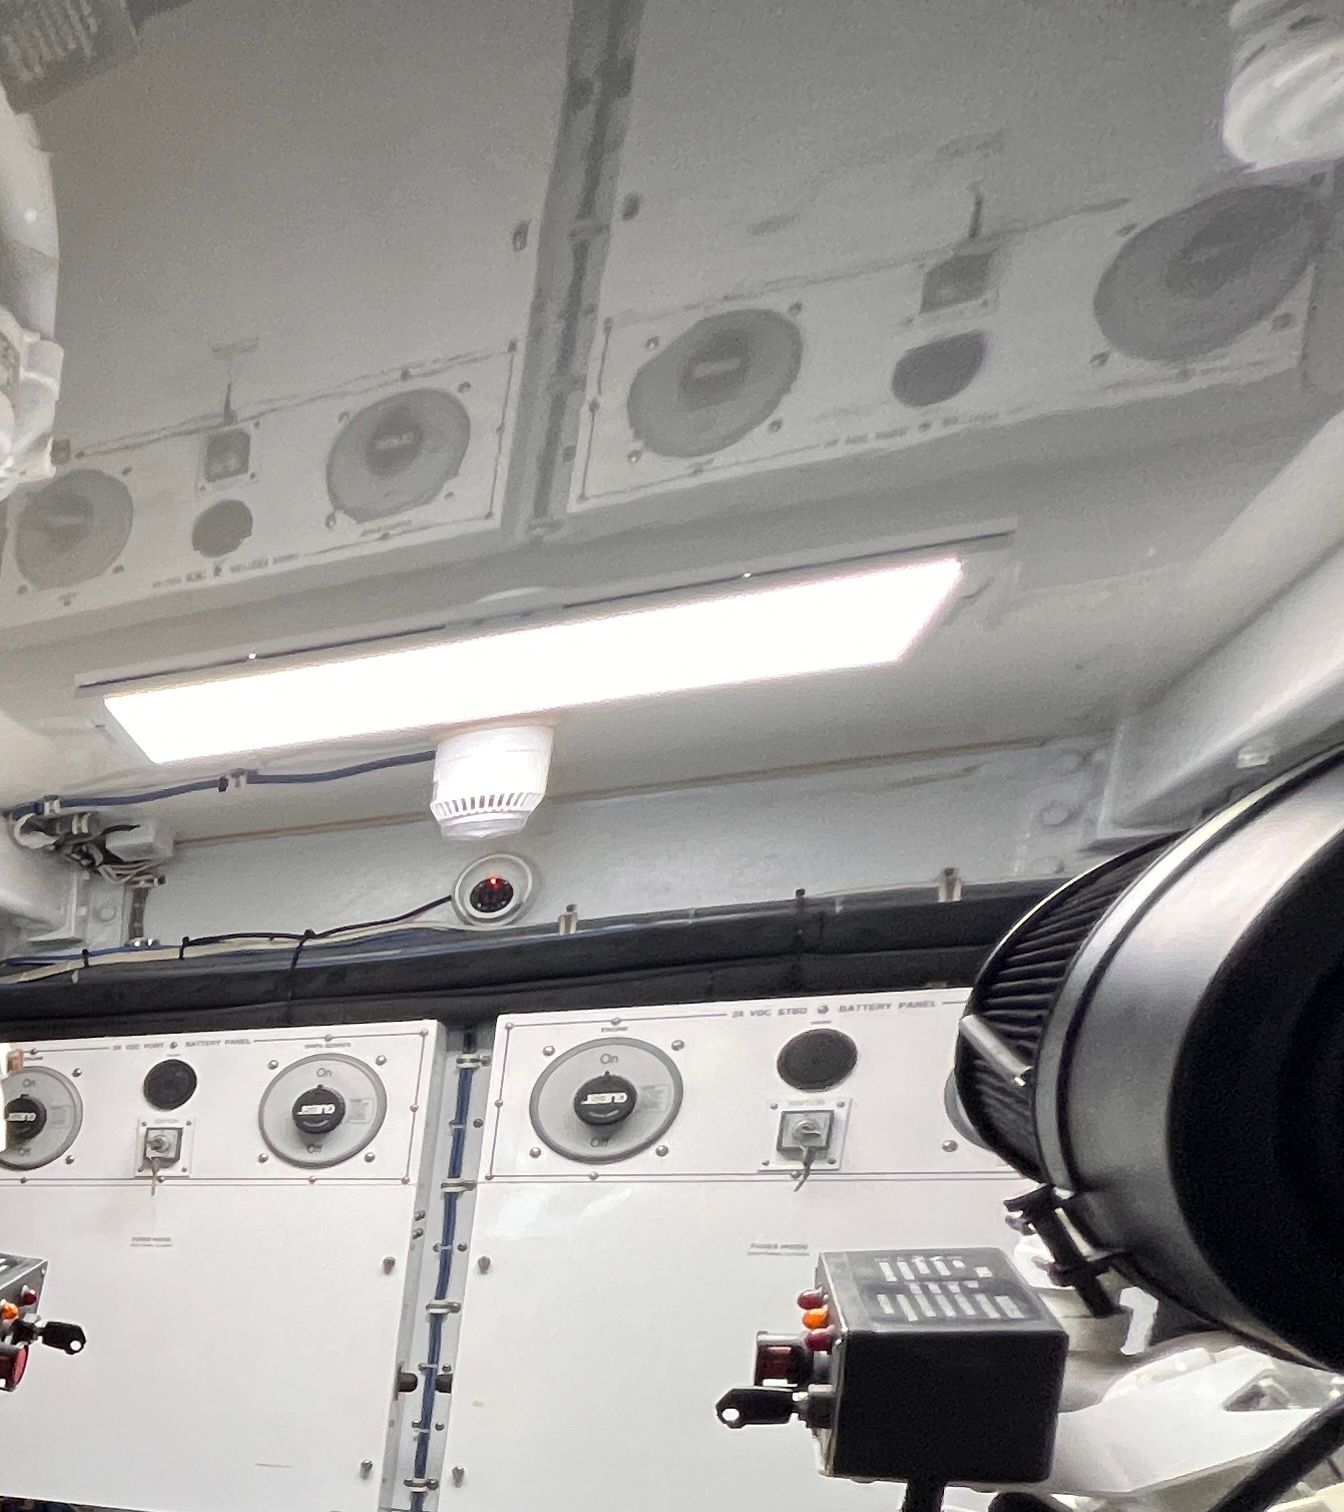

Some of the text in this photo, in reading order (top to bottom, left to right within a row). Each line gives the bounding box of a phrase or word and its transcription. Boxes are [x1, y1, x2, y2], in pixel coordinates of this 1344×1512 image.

[838, 1002, 892, 1013] BATTERY
[898, 1000, 937, 1009] PANEL
[185, 1040, 221, 1048] BATTERY
[224, 1038, 251, 1046] PANEL
[599, 1053, 619, 1065] On
[316, 1067, 333, 1078] On
[22, 1078, 36, 1088] On
[589, 1135, 610, 1148] Off
[306, 1143, 324, 1154] Off
